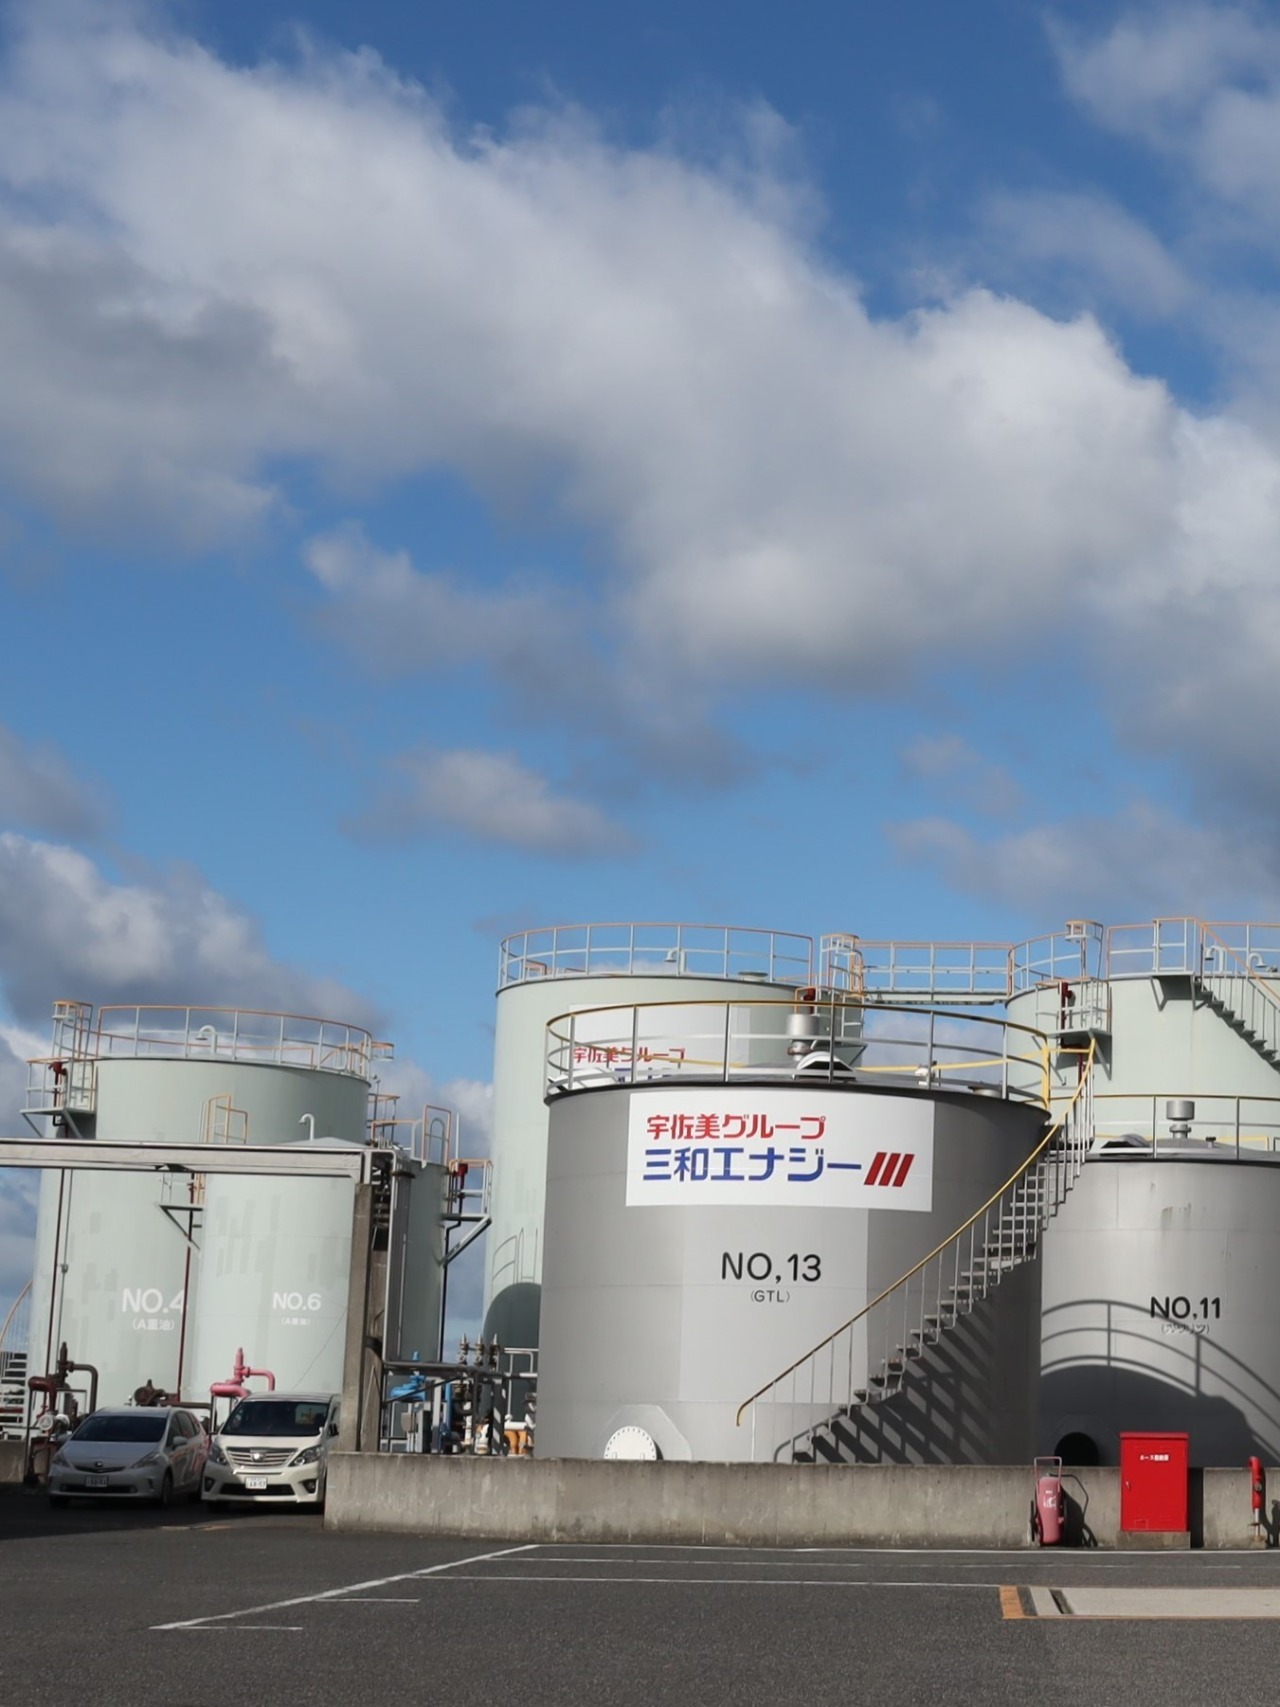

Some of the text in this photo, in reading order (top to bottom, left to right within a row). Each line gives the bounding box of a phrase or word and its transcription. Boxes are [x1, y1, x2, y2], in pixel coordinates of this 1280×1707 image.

[647, 1114, 826, 1139] 宇佐美グループ
[643, 1147, 862, 1182] 三和エナジー
[122, 1288, 188, 1313] NO.4
[272, 1292, 322, 1311] NO.6
[751, 1290, 790, 1302] (GTL)
